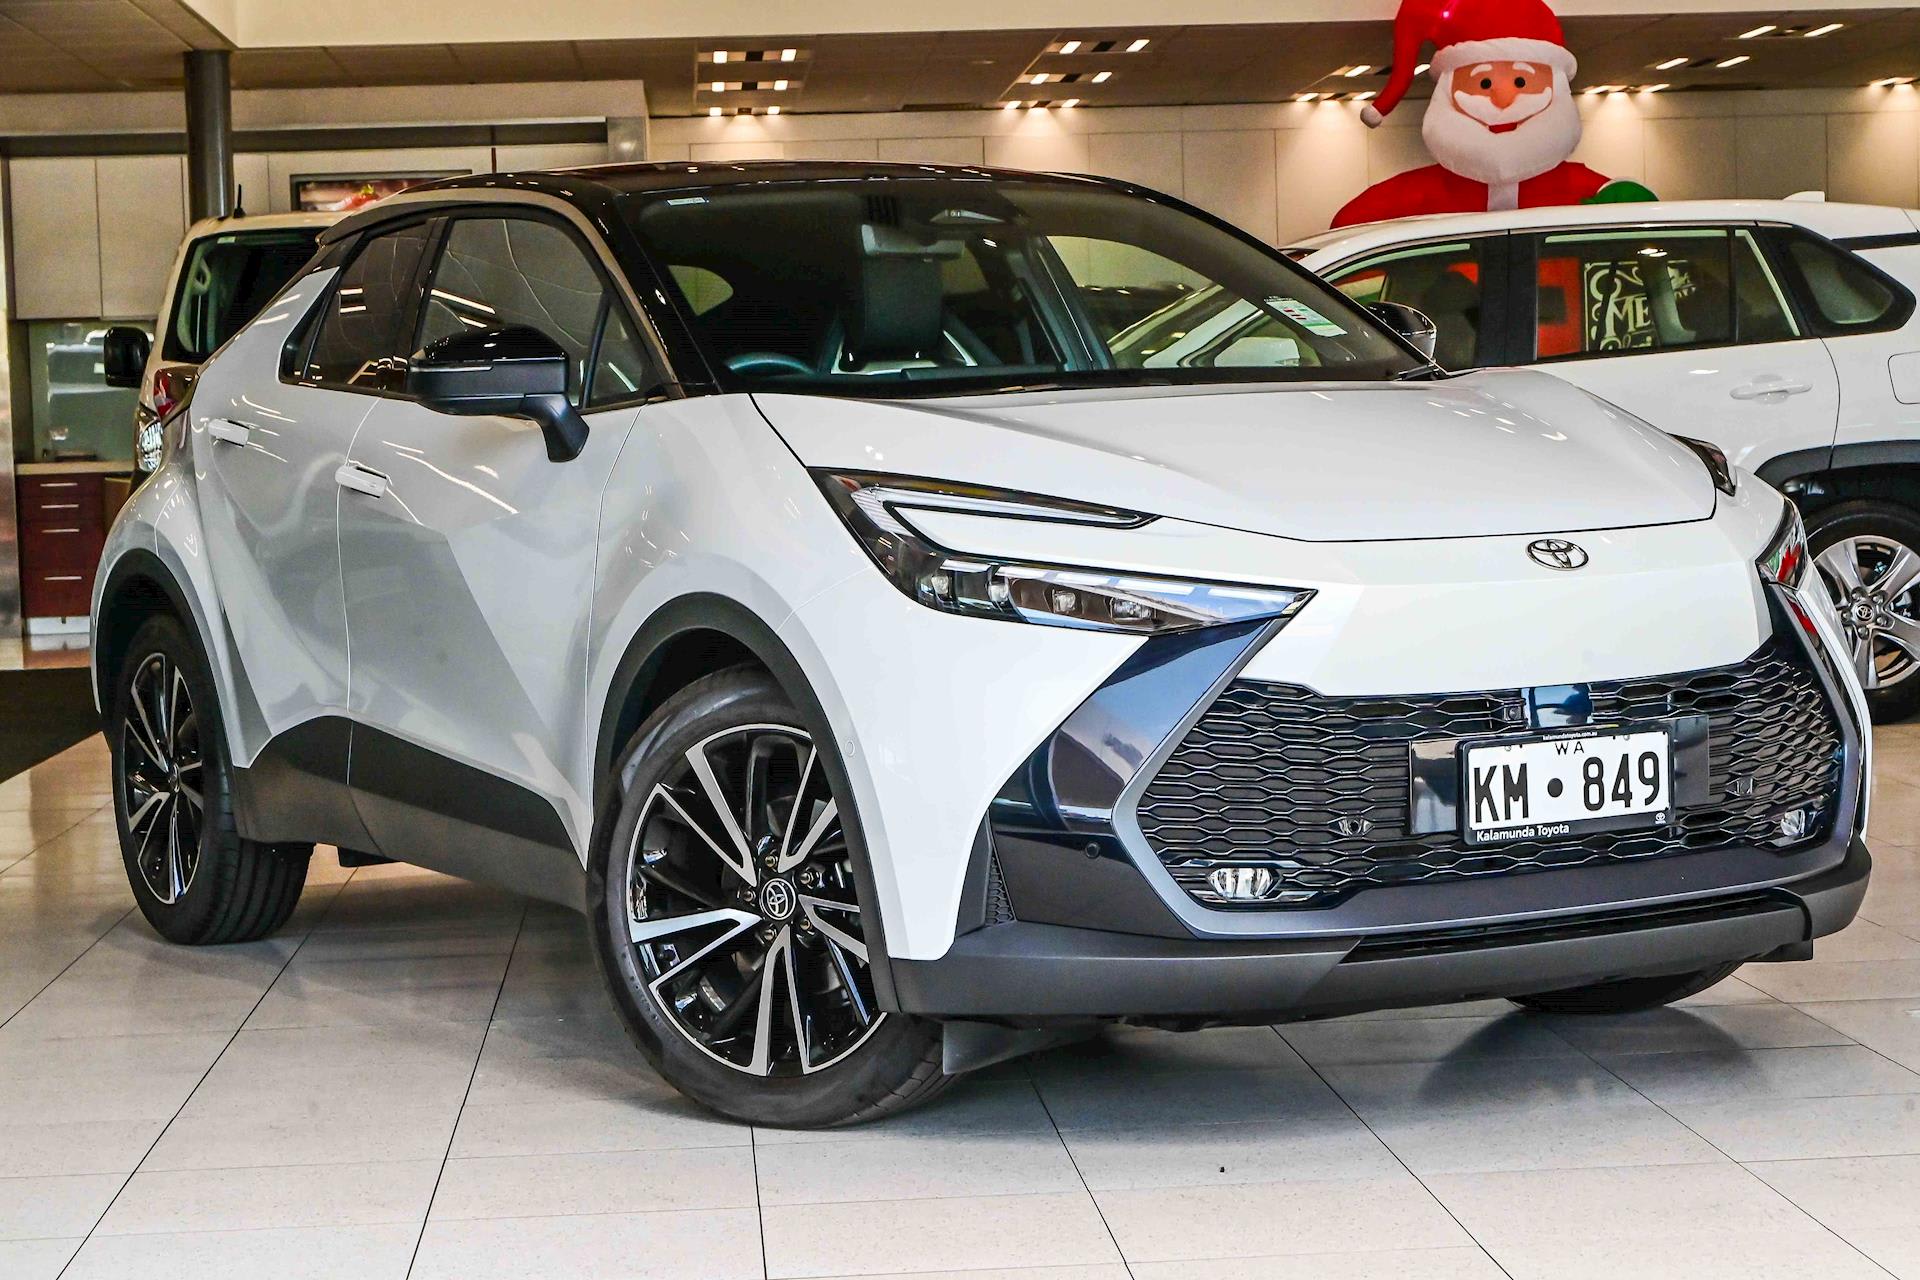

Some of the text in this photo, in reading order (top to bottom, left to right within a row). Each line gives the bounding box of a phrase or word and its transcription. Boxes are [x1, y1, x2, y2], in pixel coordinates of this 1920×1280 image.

[1555, 741, 1585, 755] WA
[1474, 751, 1660, 823] KM 849
[1476, 823, 1570, 842] Kalamunda Toyota
